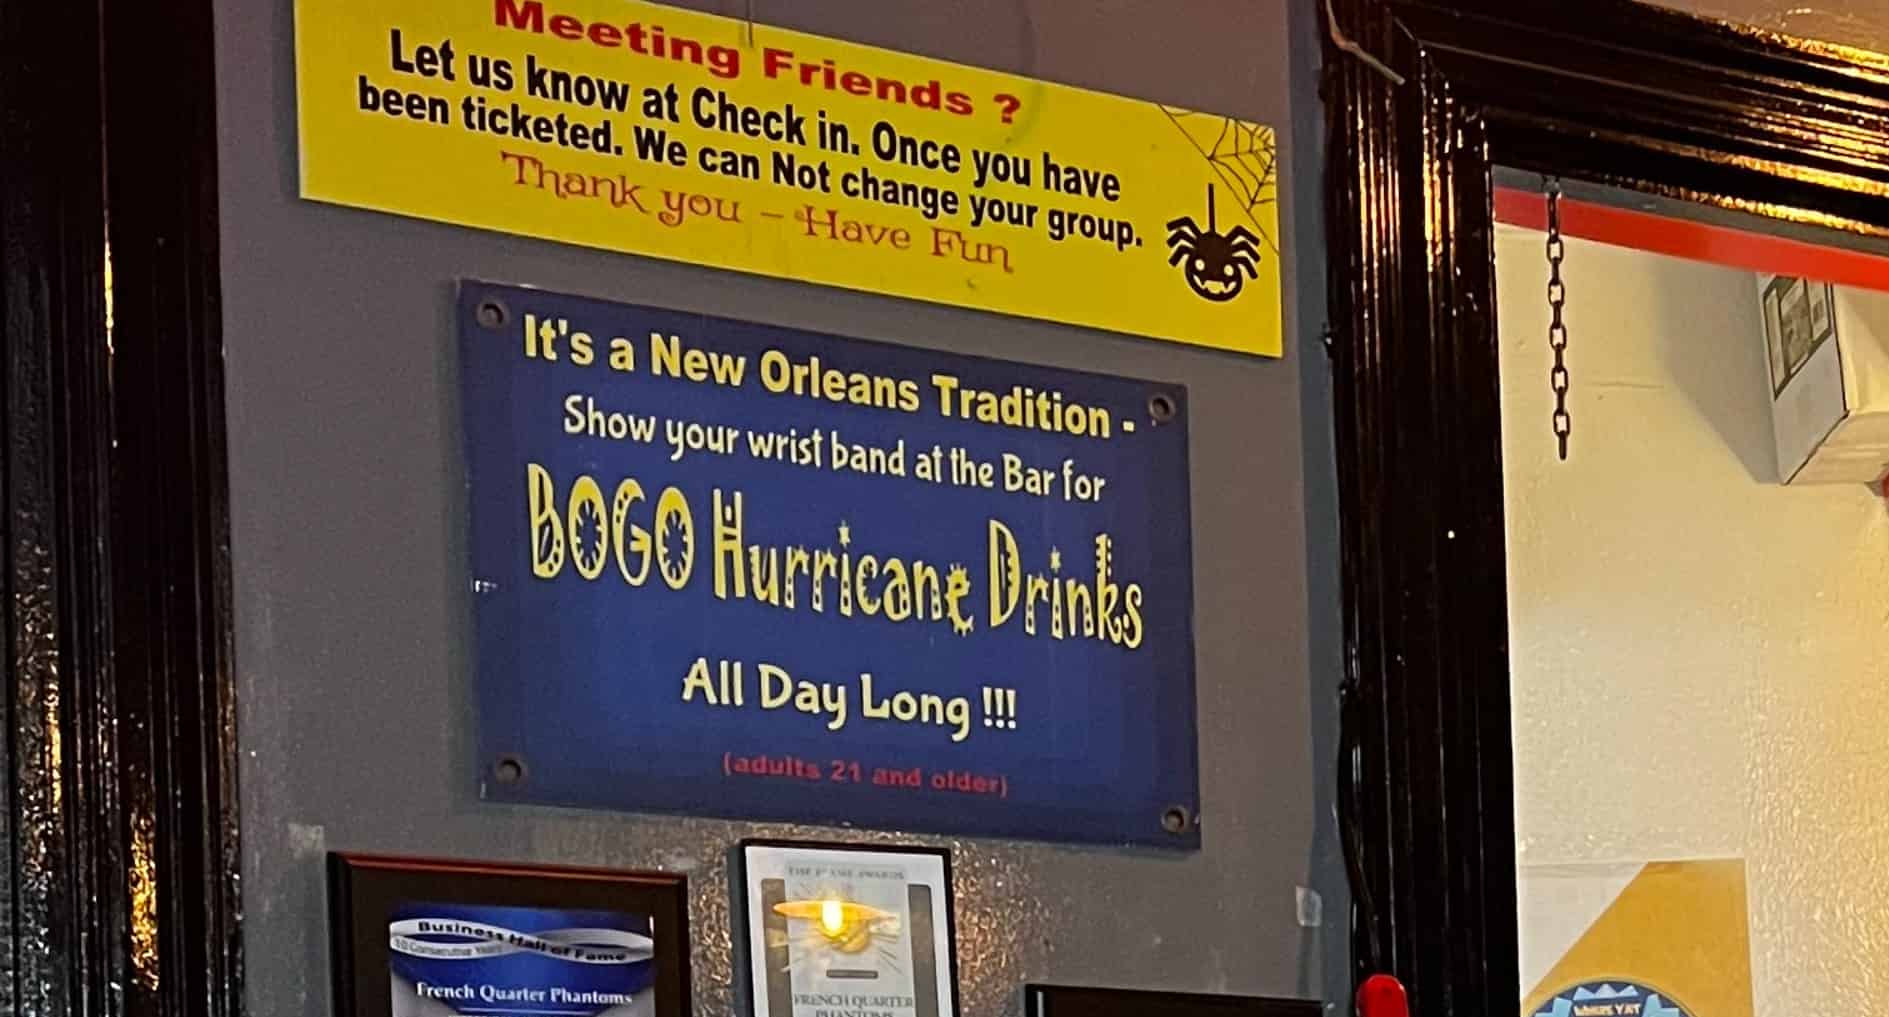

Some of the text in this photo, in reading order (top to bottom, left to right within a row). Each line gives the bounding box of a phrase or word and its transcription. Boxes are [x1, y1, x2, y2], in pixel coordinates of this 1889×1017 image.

[390, 28, 1121, 202] Let us know at Check in. Once you have
[494, 0, 1023, 124] Meeting Friends ?
[358, 75, 1144, 250] been ticketed. We can Not change your group.
[500, 149, 1014, 274] Thank you Have Fun
[524, 314, 594, 366] It's
[609, 336, 636, 372] a
[650, 332, 746, 387] New
[760, 349, 920, 412] Orleans
[932, 373, 1111, 438] Tradition
[564, 394, 1106, 502] Show your wrist band at the Bar for
[527, 462, 1143, 649] BOGO Hurricane Drinks
[682, 657, 1017, 742] All Day Long !!!
[723, 752, 1008, 798] (adults 21 and older)
[415, 981, 634, 1006] French Quarter Phantoms
[418, 921, 503, 943] Business
[509, 932, 546, 953] Hall
[549, 944, 570, 958] of
[574, 949, 628, 963] Fame
[794, 991, 914, 1010] FRENCH QUARTER
